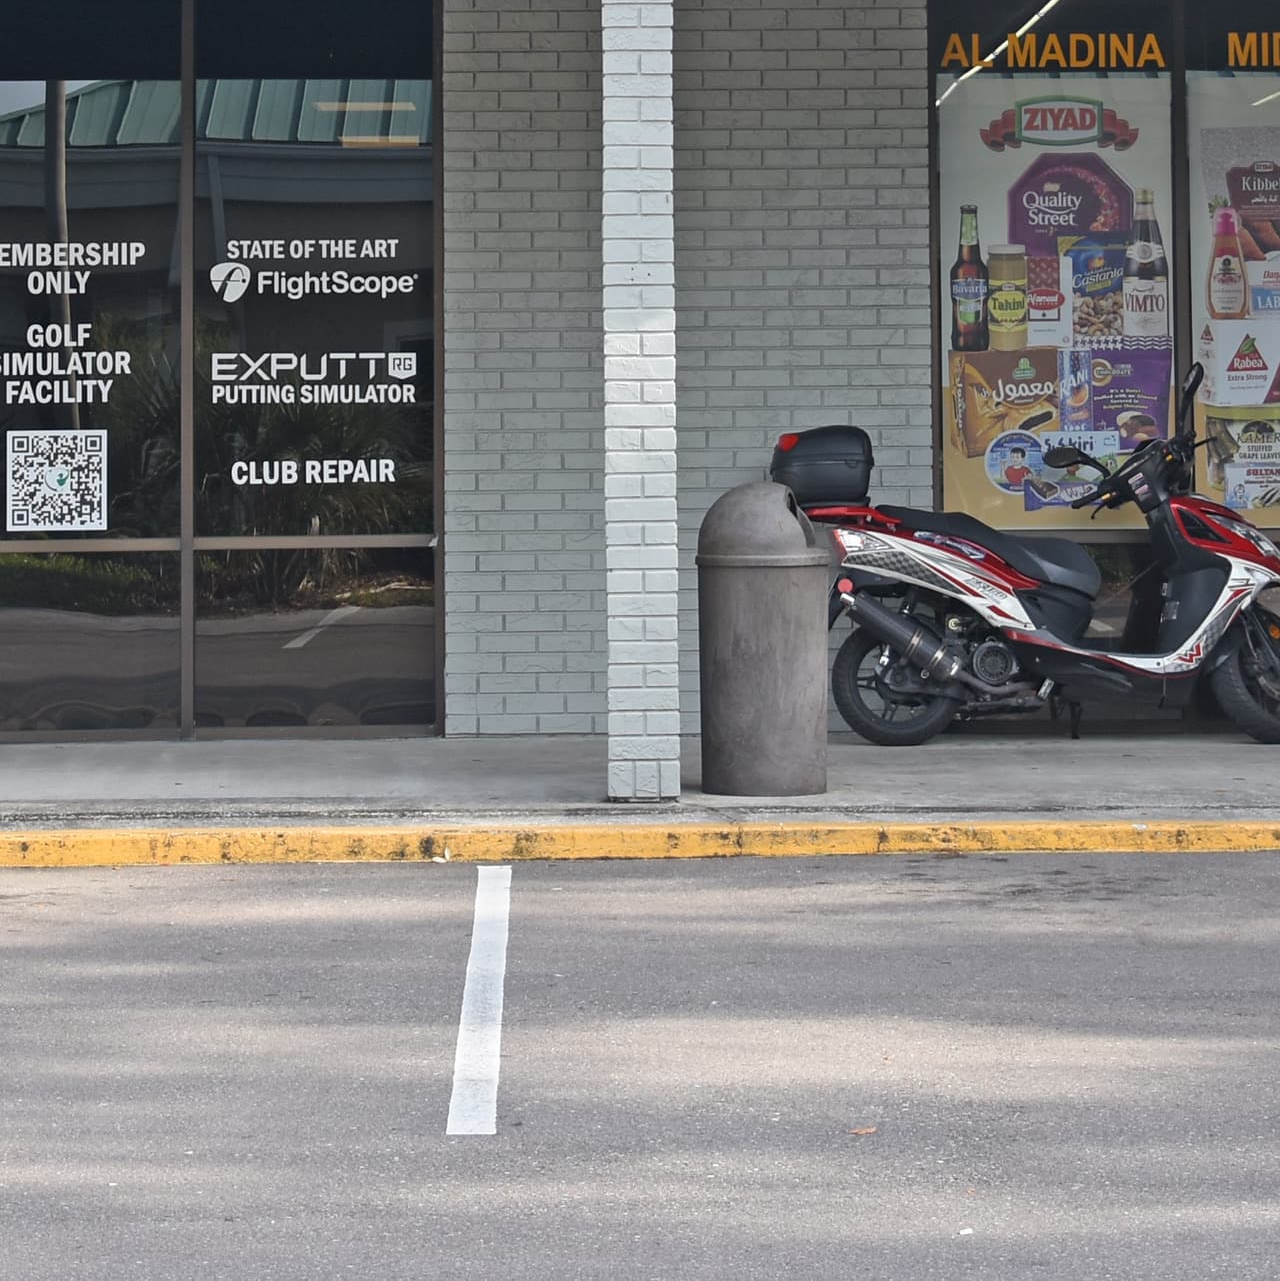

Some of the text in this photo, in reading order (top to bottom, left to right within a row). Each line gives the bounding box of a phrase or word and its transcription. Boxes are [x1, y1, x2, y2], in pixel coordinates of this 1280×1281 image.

[941, 32, 1166, 68] AL MADINA
[1023, 108, 1096, 131] ZIYAD
[1023, 191, 1082, 210] Quality
[1028, 211, 1076, 227] Street
[227, 239, 399, 259] STATE OF THE ART
[27, 271, 91, 295] ONLY
[257, 270, 414, 299] FlightScope
[952, 284, 988, 295] Bavaria
[991, 297, 1025, 311] Tahini
[1125, 293, 1165, 312] VIMTO
[27, 323, 92, 348] GOLF
[211, 352, 387, 381] EXPUTT
[1233, 356, 1263, 369] Rabea
[991, 378, 1054, 402] معمول
[1060, 369, 1089, 399] RANI
[1246, 374, 1267, 383] Strong
[5, 379, 113, 404] FACILITY
[212, 385, 416, 405] PUTTING SIMULATOR
[231, 459, 395, 485] CLUB REPAIR
